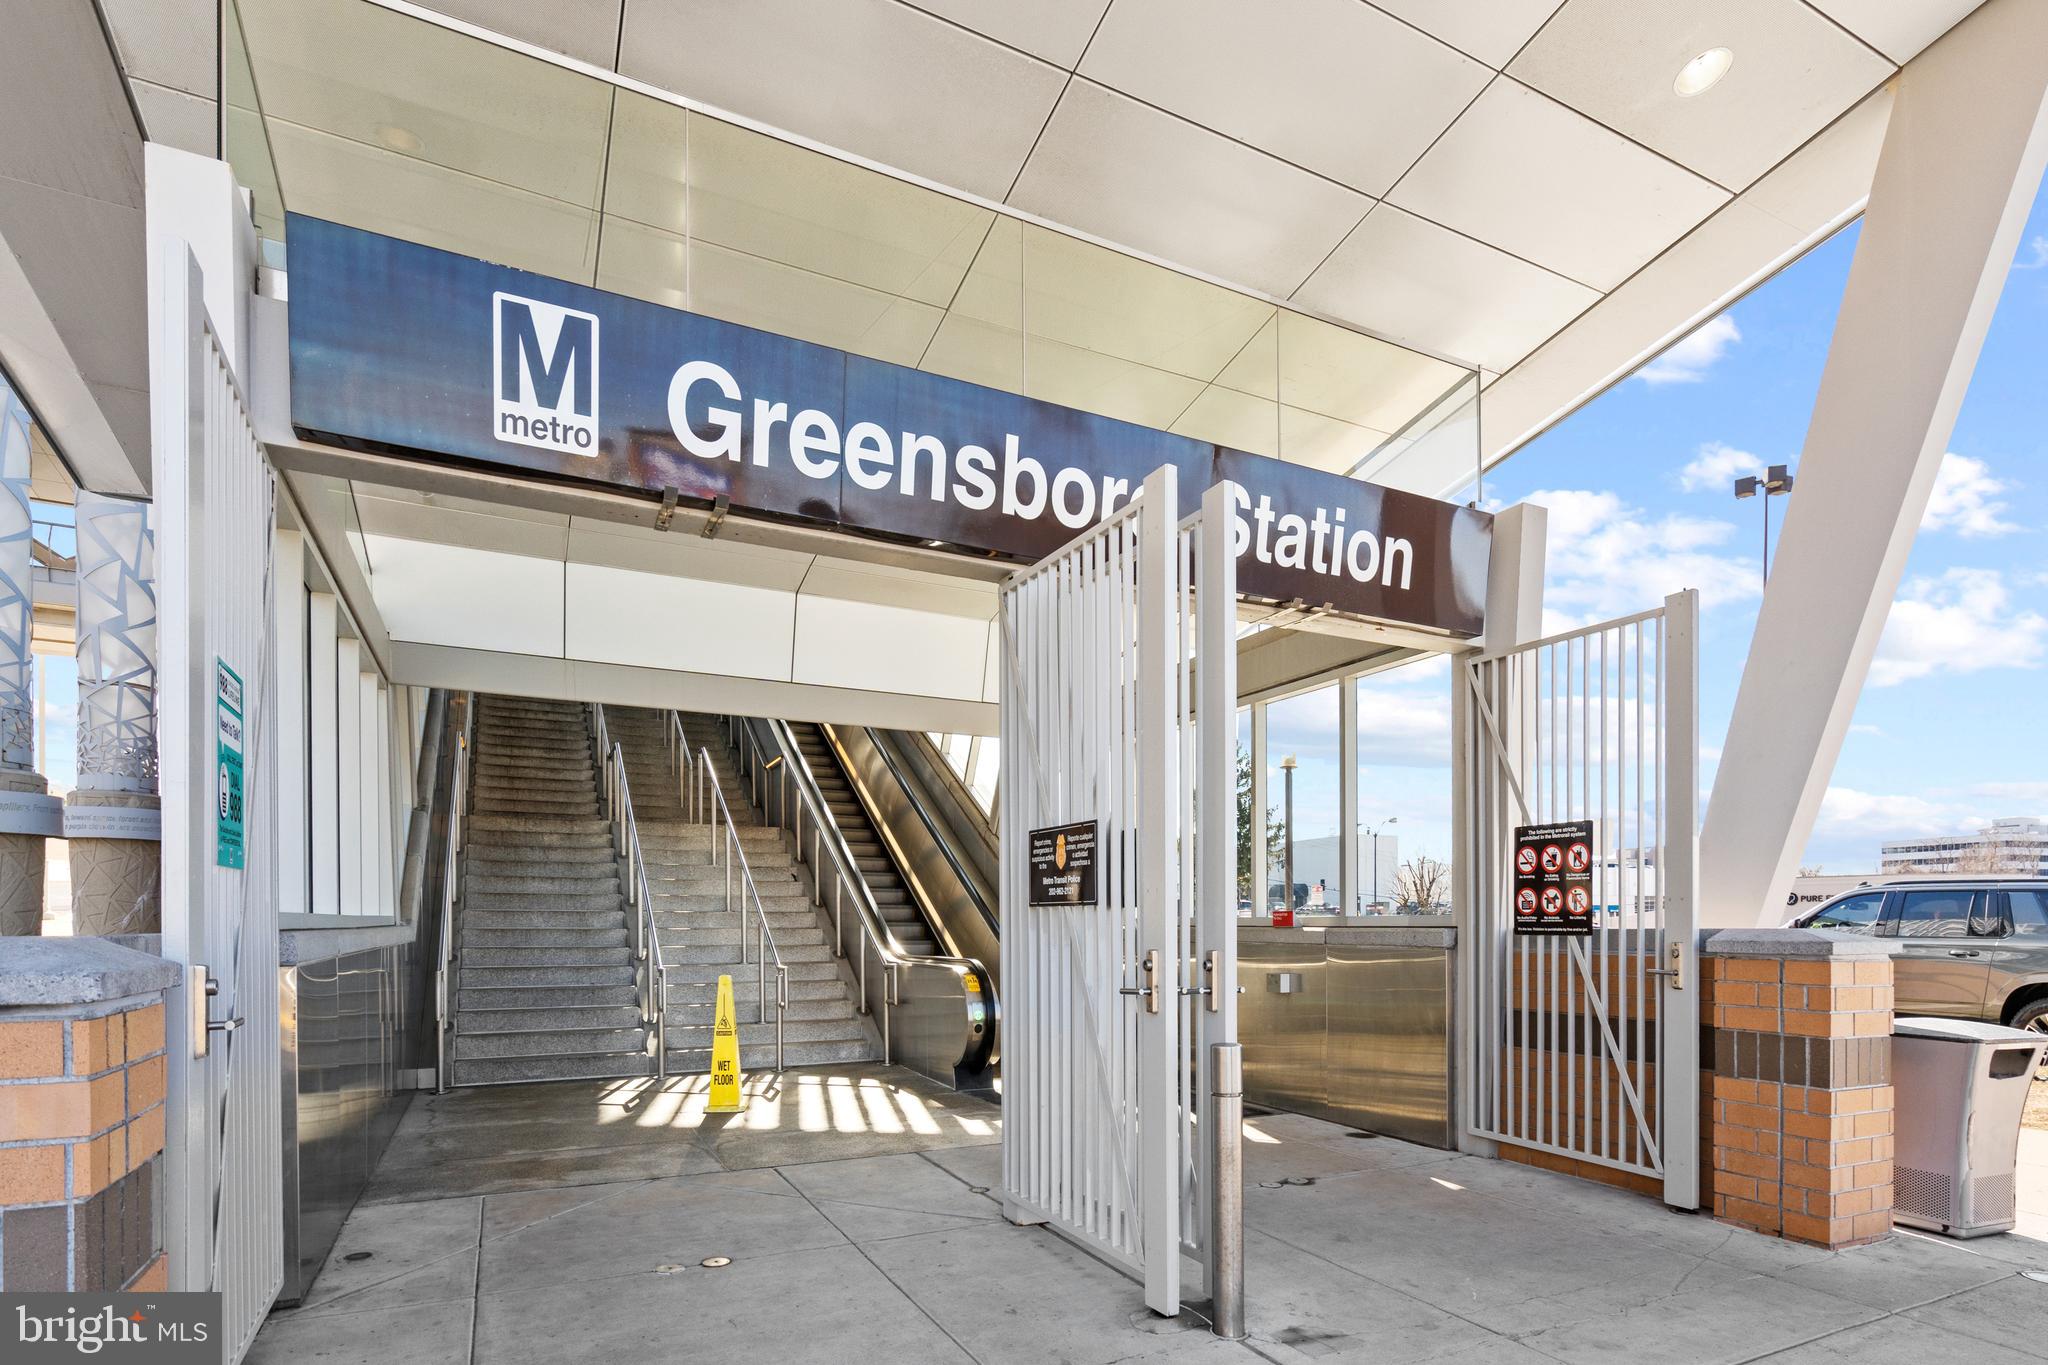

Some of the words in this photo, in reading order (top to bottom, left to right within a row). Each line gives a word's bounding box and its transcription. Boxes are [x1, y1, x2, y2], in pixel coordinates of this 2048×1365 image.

[501, 299, 592, 417] M
[501, 411, 592, 449] metro
[668, 360, 1144, 535] Greensbor
[220, 715, 228, 734] Need
[230, 772, 240, 791] DIAL
[230, 792, 242, 824] 988
[1054, 876, 1067, 884] Transit
[718, 1060, 730, 1071] WET
[714, 1074, 734, 1085] FLOOR
